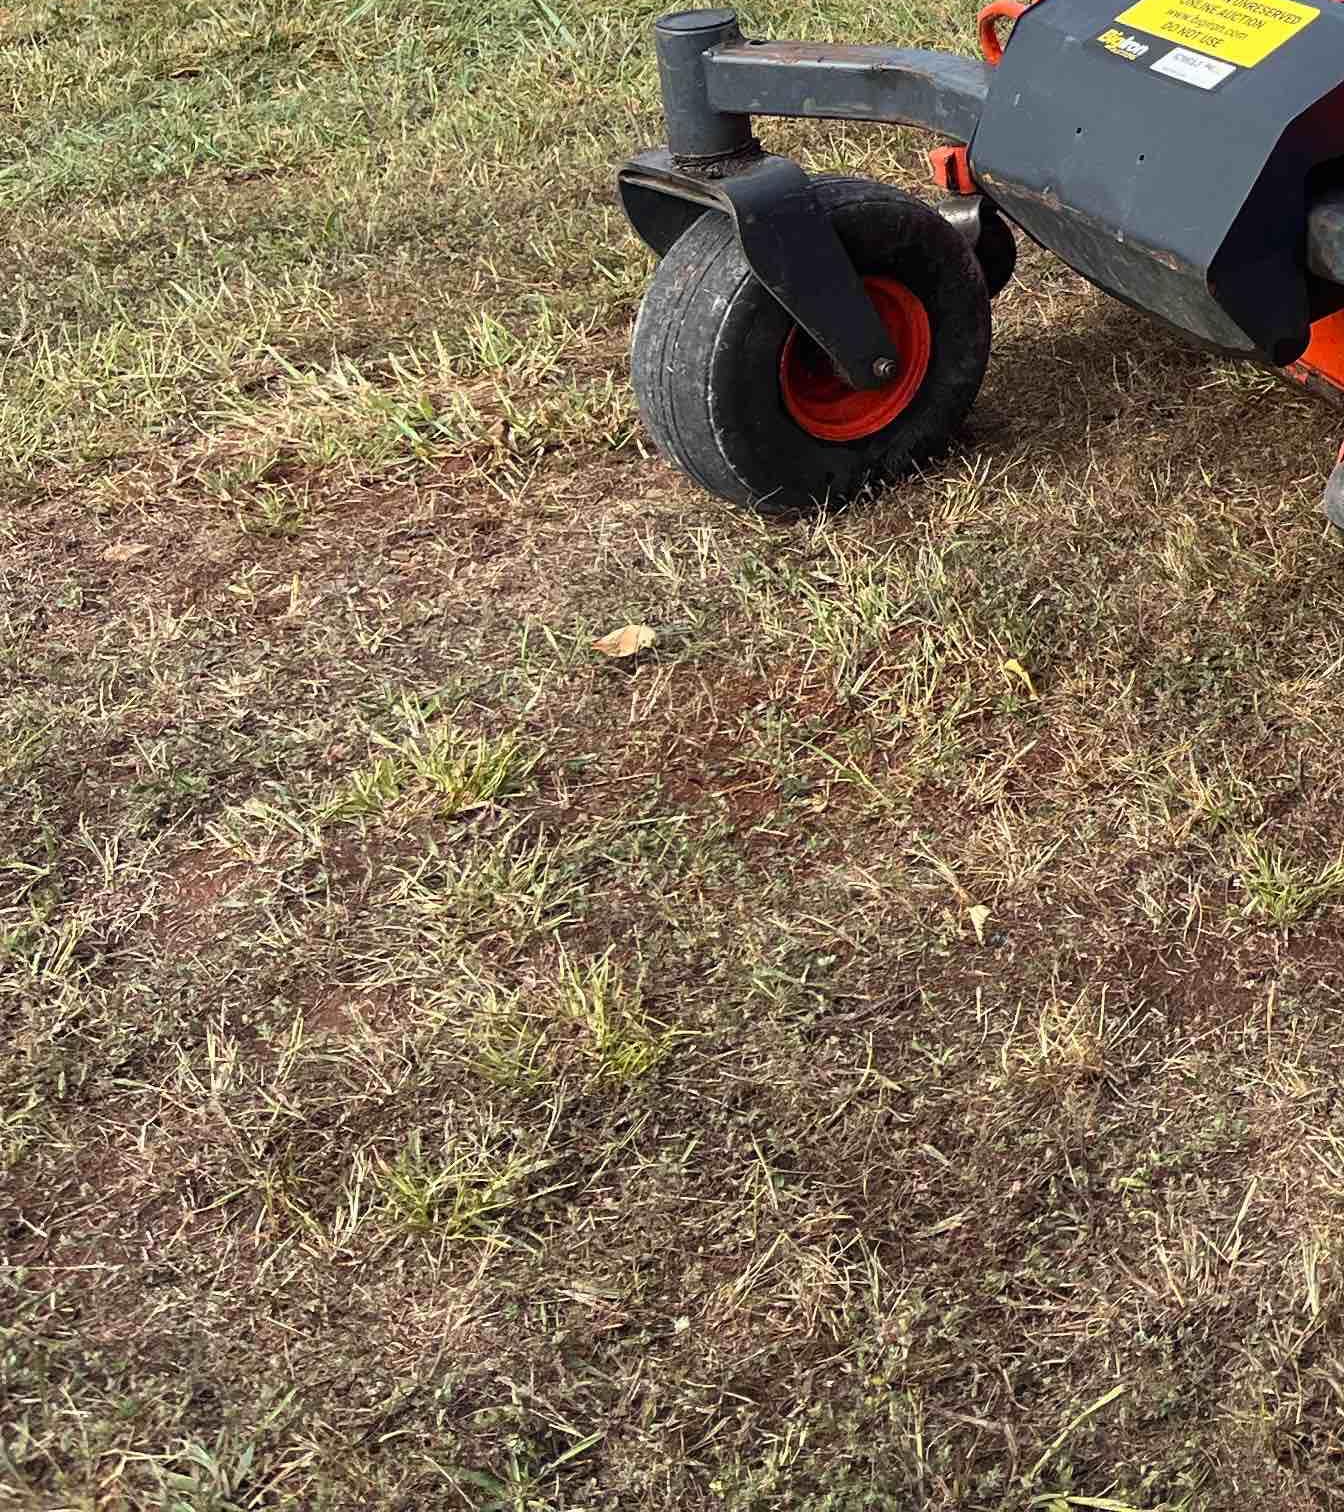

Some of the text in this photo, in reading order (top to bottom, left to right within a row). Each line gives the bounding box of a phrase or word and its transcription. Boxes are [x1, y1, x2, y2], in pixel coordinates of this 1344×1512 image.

[1218, 6, 1265, 29] AUCTION
[1160, 22, 1225, 49] DO NOT USE
